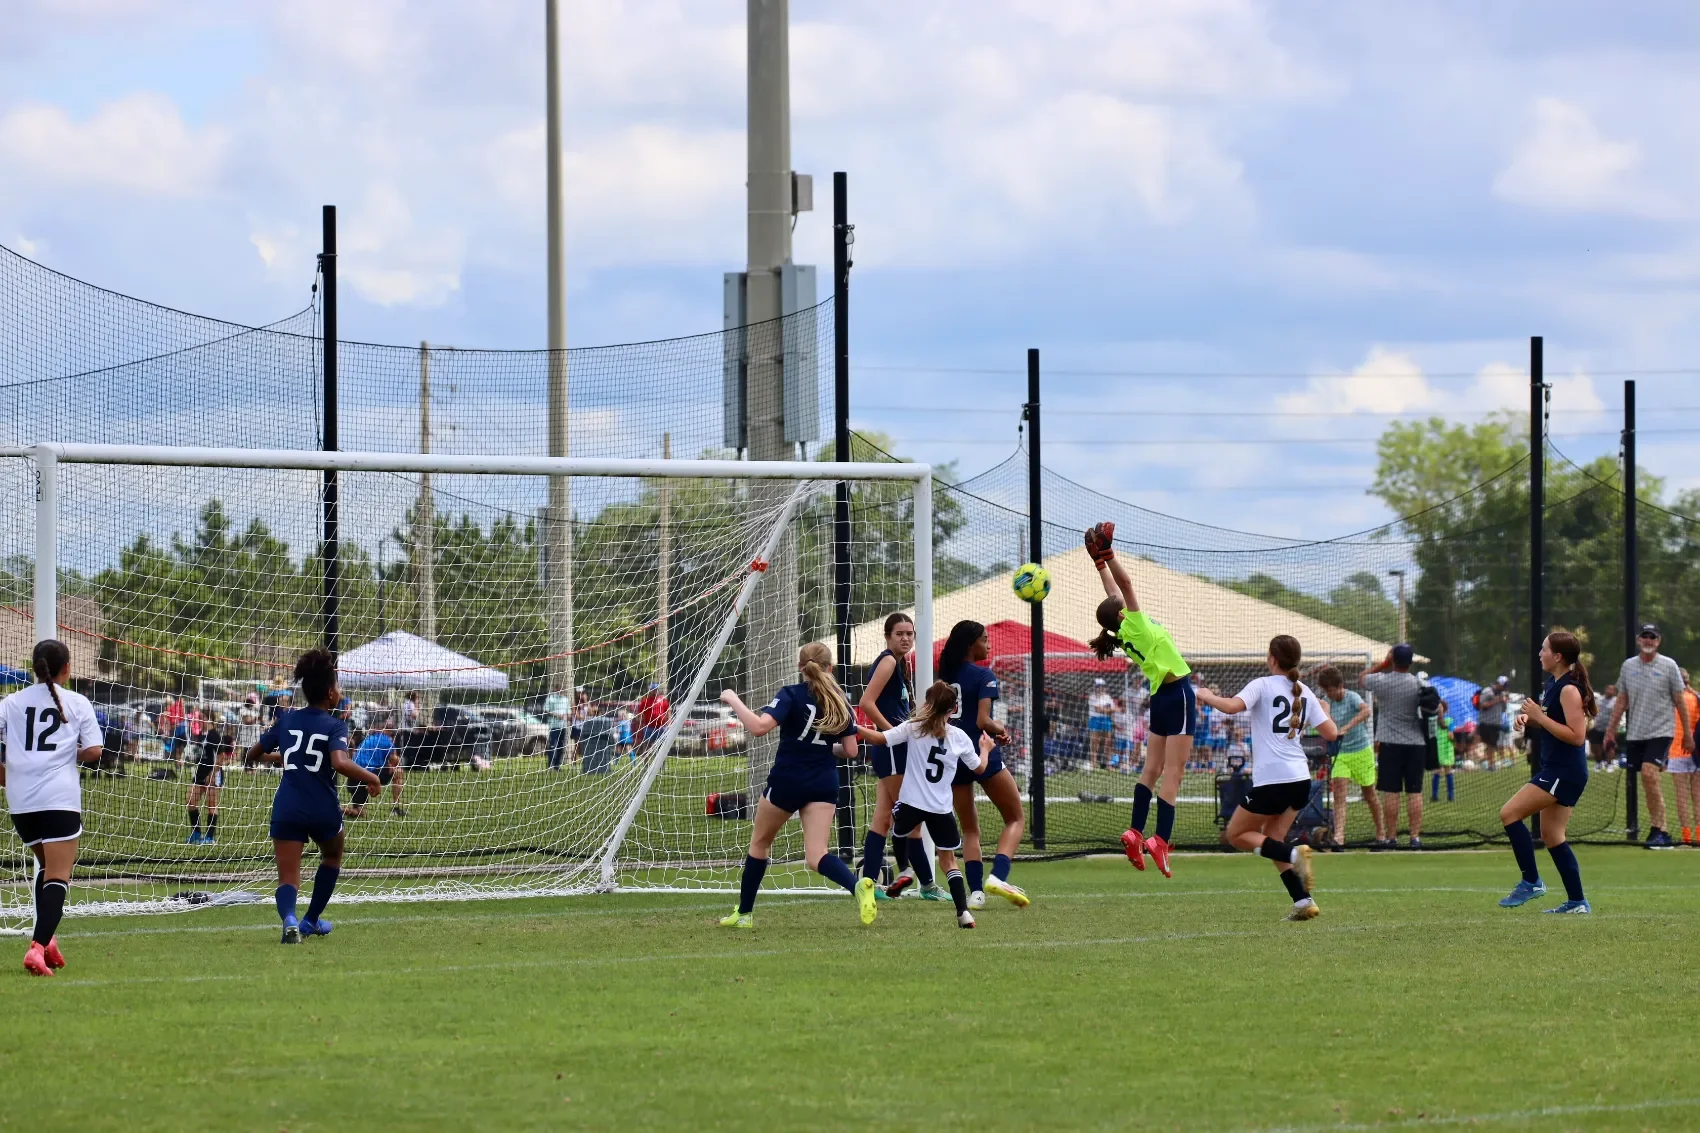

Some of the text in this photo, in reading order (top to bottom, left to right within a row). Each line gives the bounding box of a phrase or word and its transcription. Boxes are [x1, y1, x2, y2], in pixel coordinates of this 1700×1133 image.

[25, 706, 61, 751] 12
[283, 729, 330, 773] 25
[925, 745, 948, 784] 5
